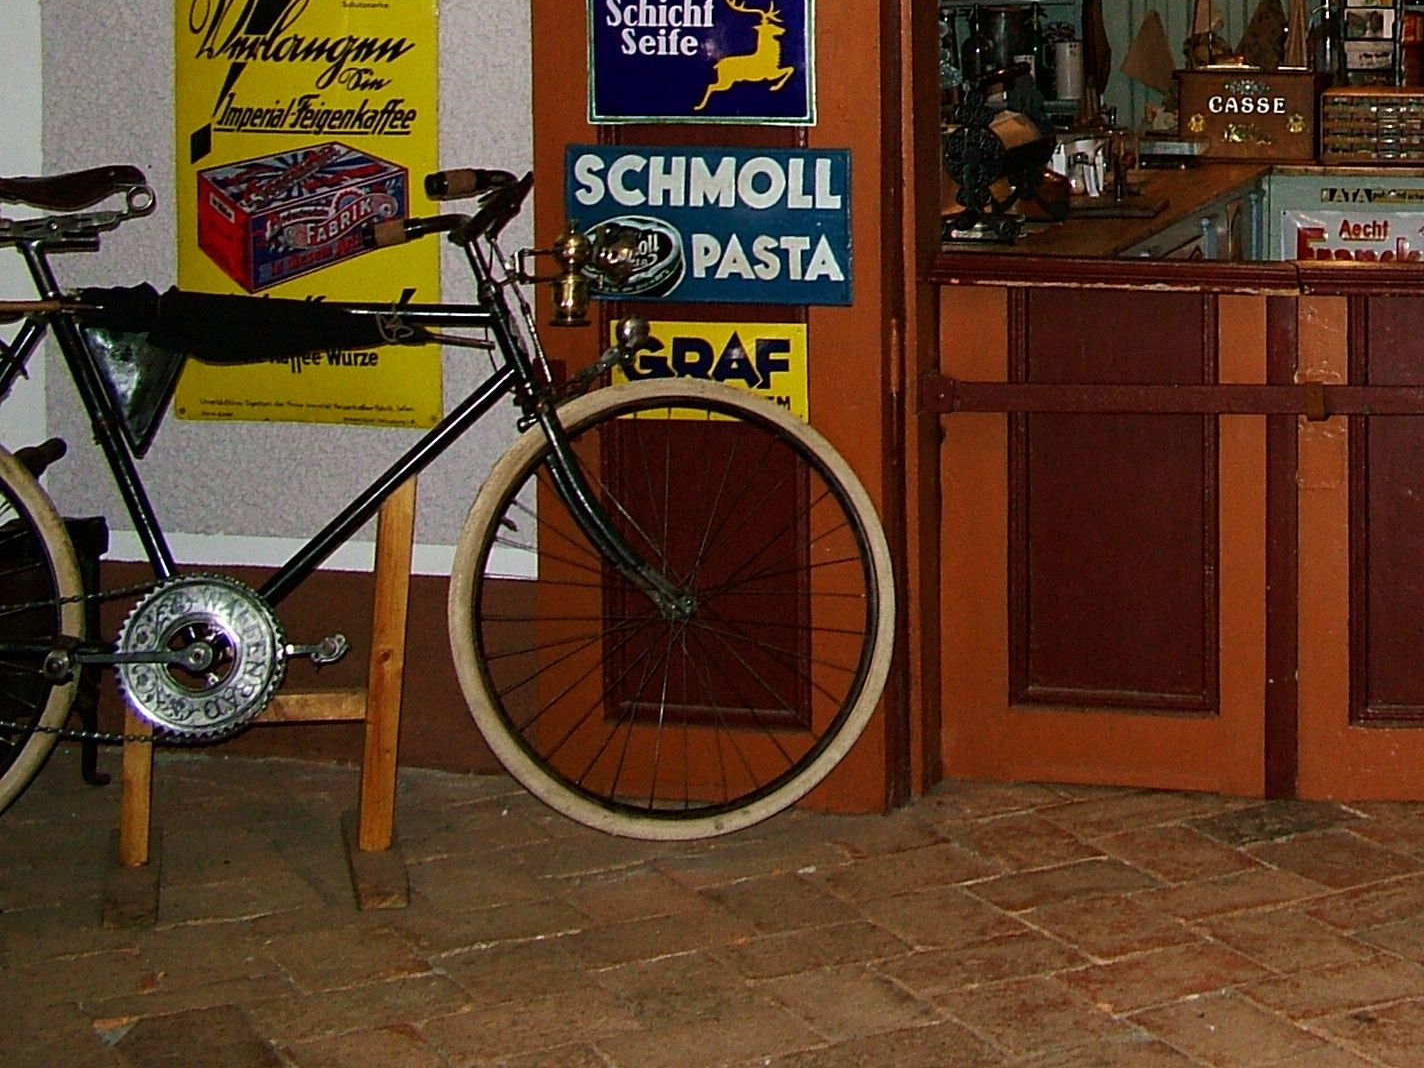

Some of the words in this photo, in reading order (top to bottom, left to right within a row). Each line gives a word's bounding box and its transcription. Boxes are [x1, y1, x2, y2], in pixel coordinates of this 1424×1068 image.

[621, 28, 698, 56] Seife
[217, 92, 417, 135] Imperial-Feigenkaffee
[1208, 96, 1286, 114] CASSE
[575, 154, 841, 209] SCHMOLL
[306, 198, 372, 244] FABRIK
[1339, 218, 1389, 241] Aecht
[692, 234, 844, 280] PASTA
[621, 330, 790, 389] GRAF
